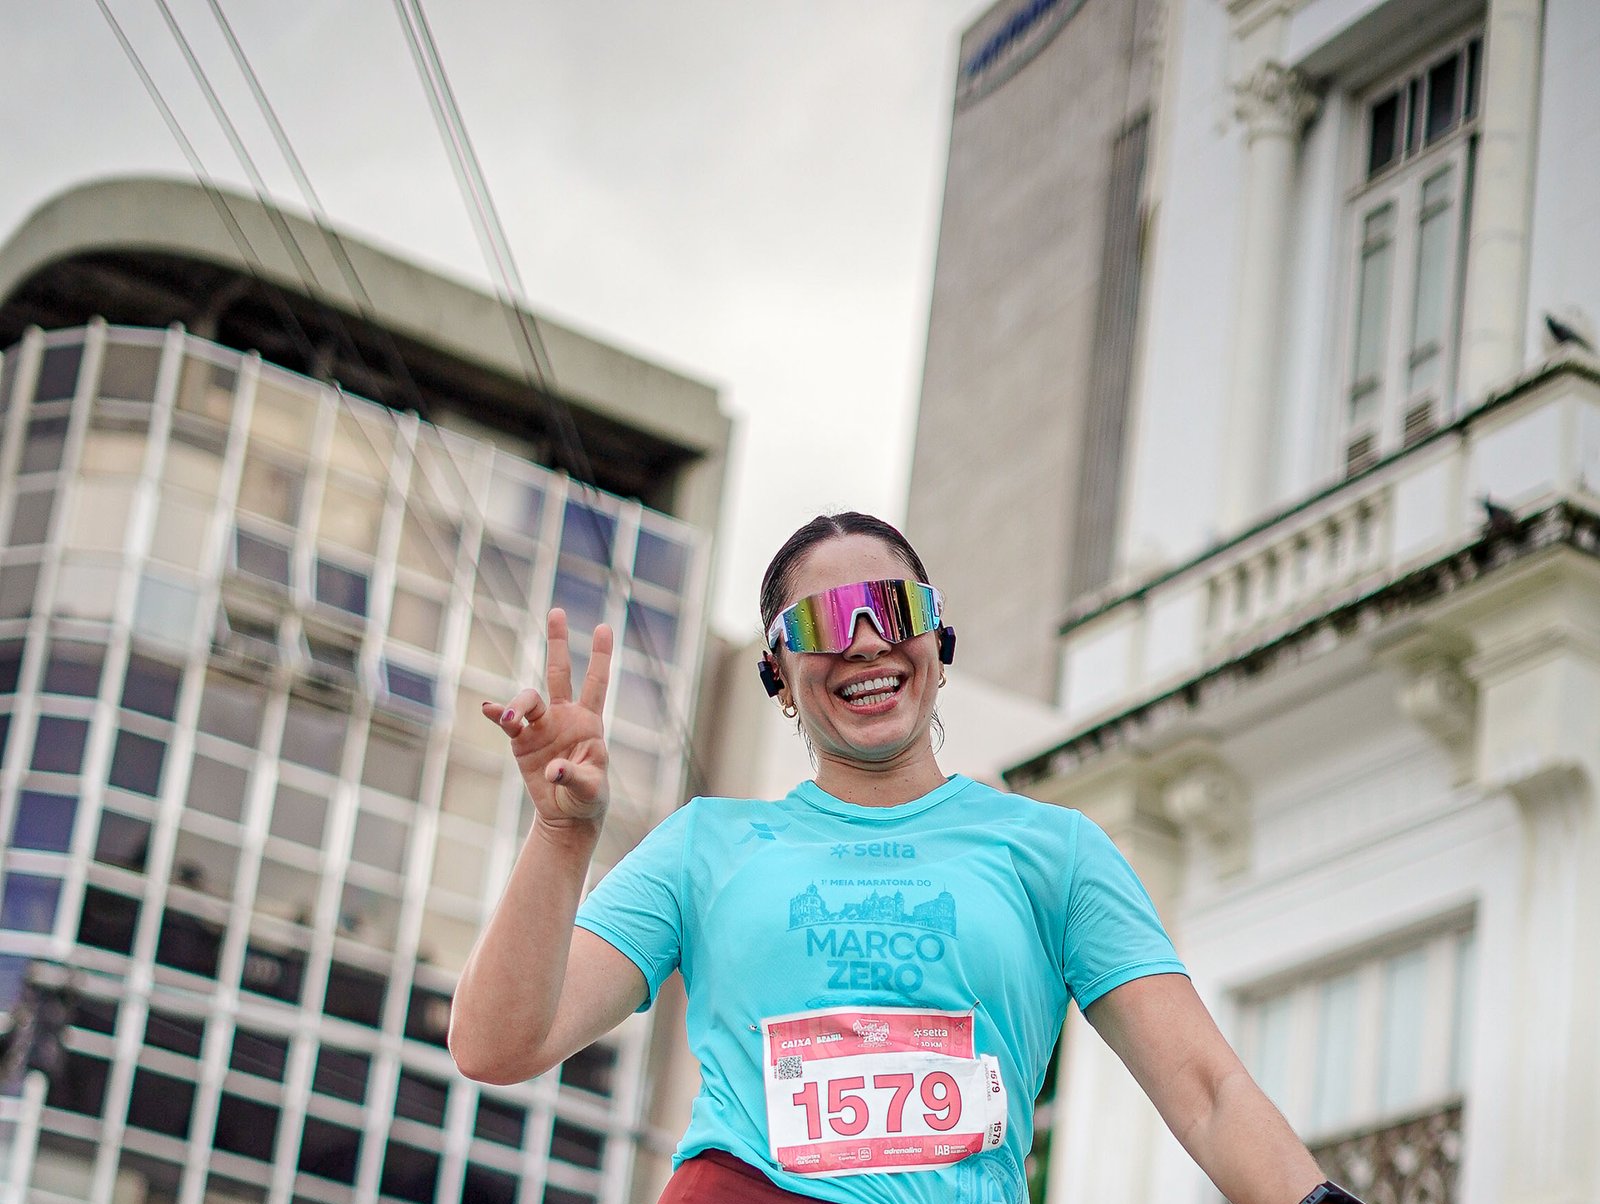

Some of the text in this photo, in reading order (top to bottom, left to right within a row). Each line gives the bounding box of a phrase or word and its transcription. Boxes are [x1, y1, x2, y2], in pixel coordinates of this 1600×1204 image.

[853, 841, 916, 859] setta
[857, 879, 914, 887] MARATONA
[806, 928, 945, 963] MARCO
[827, 960, 924, 993] ZERO
[923, 1028, 948, 1037] setta
[781, 1037, 812, 1049] CAIXA
[930, 1041, 943, 1049] KM
[989, 1069, 1000, 1094] 1579
[792, 1070, 963, 1140] 1579
[991, 1120, 1003, 1146] 1579
[934, 1144, 950, 1156] IAB
